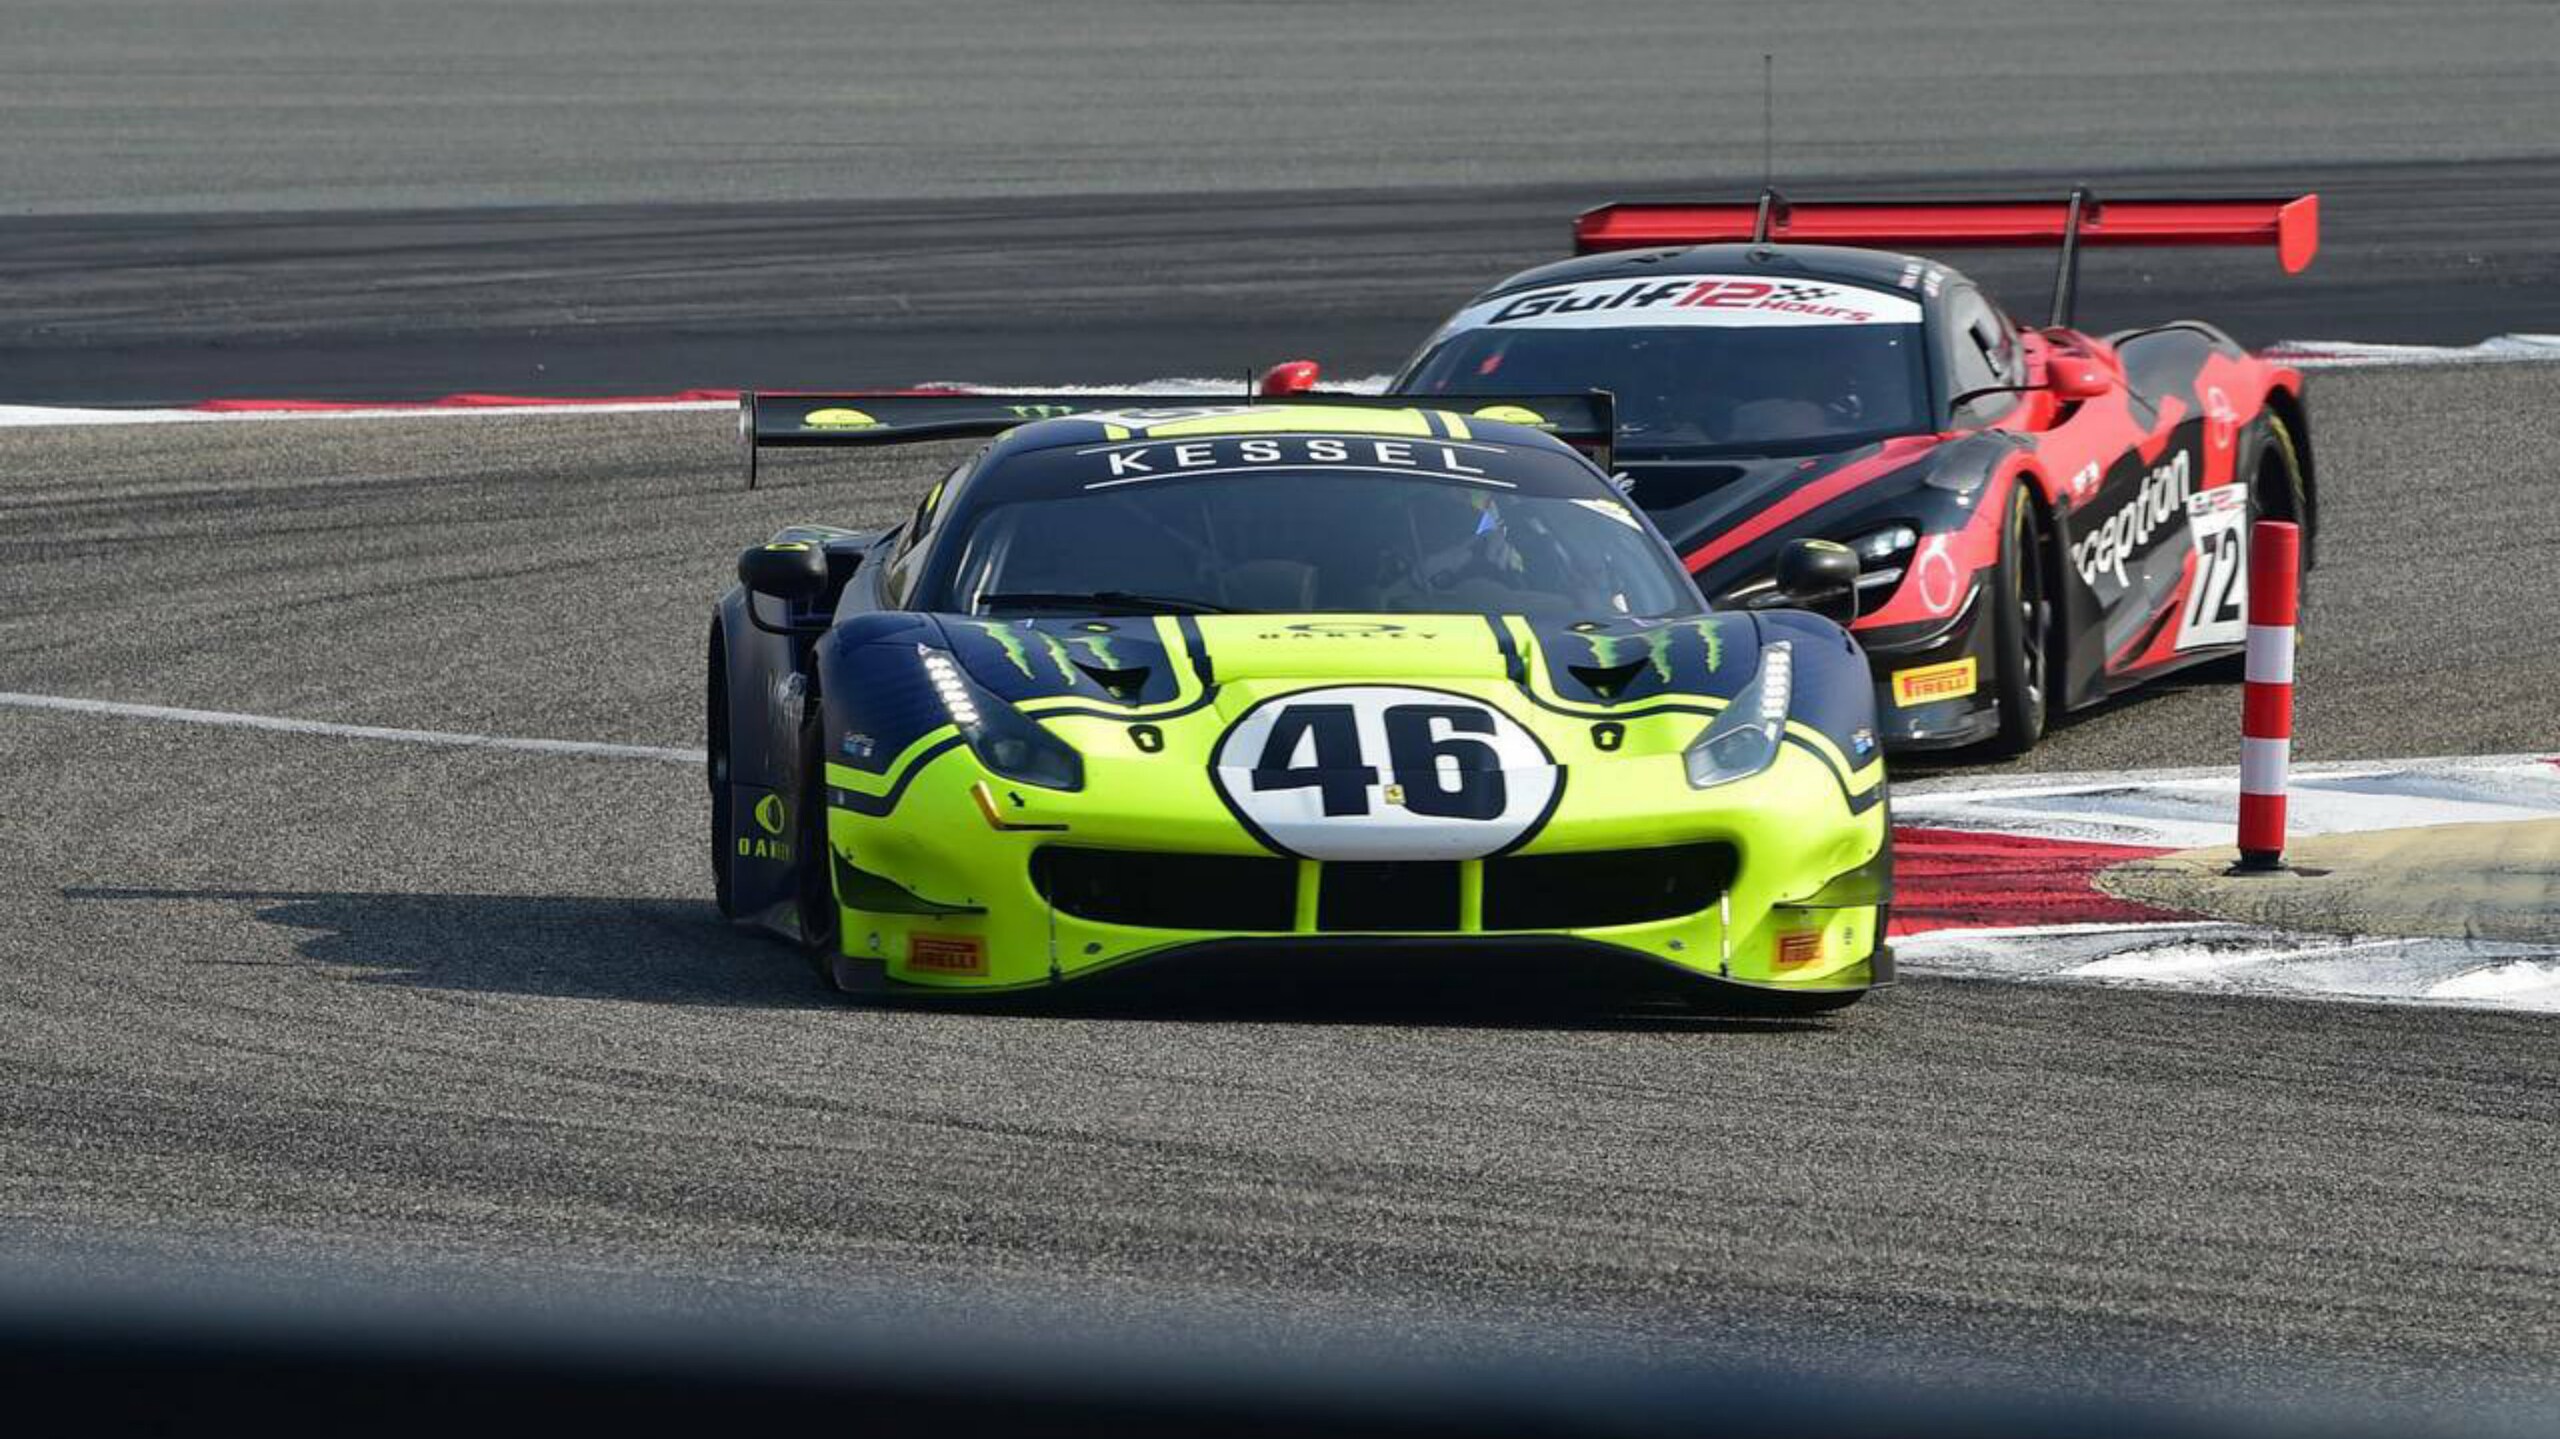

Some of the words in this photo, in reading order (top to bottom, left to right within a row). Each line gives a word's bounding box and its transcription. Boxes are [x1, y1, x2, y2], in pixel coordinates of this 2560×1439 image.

[1109, 438, 1486, 476] KESSEL
[2191, 527, 2241, 627] 72
[1251, 703, 1507, 821] 46
